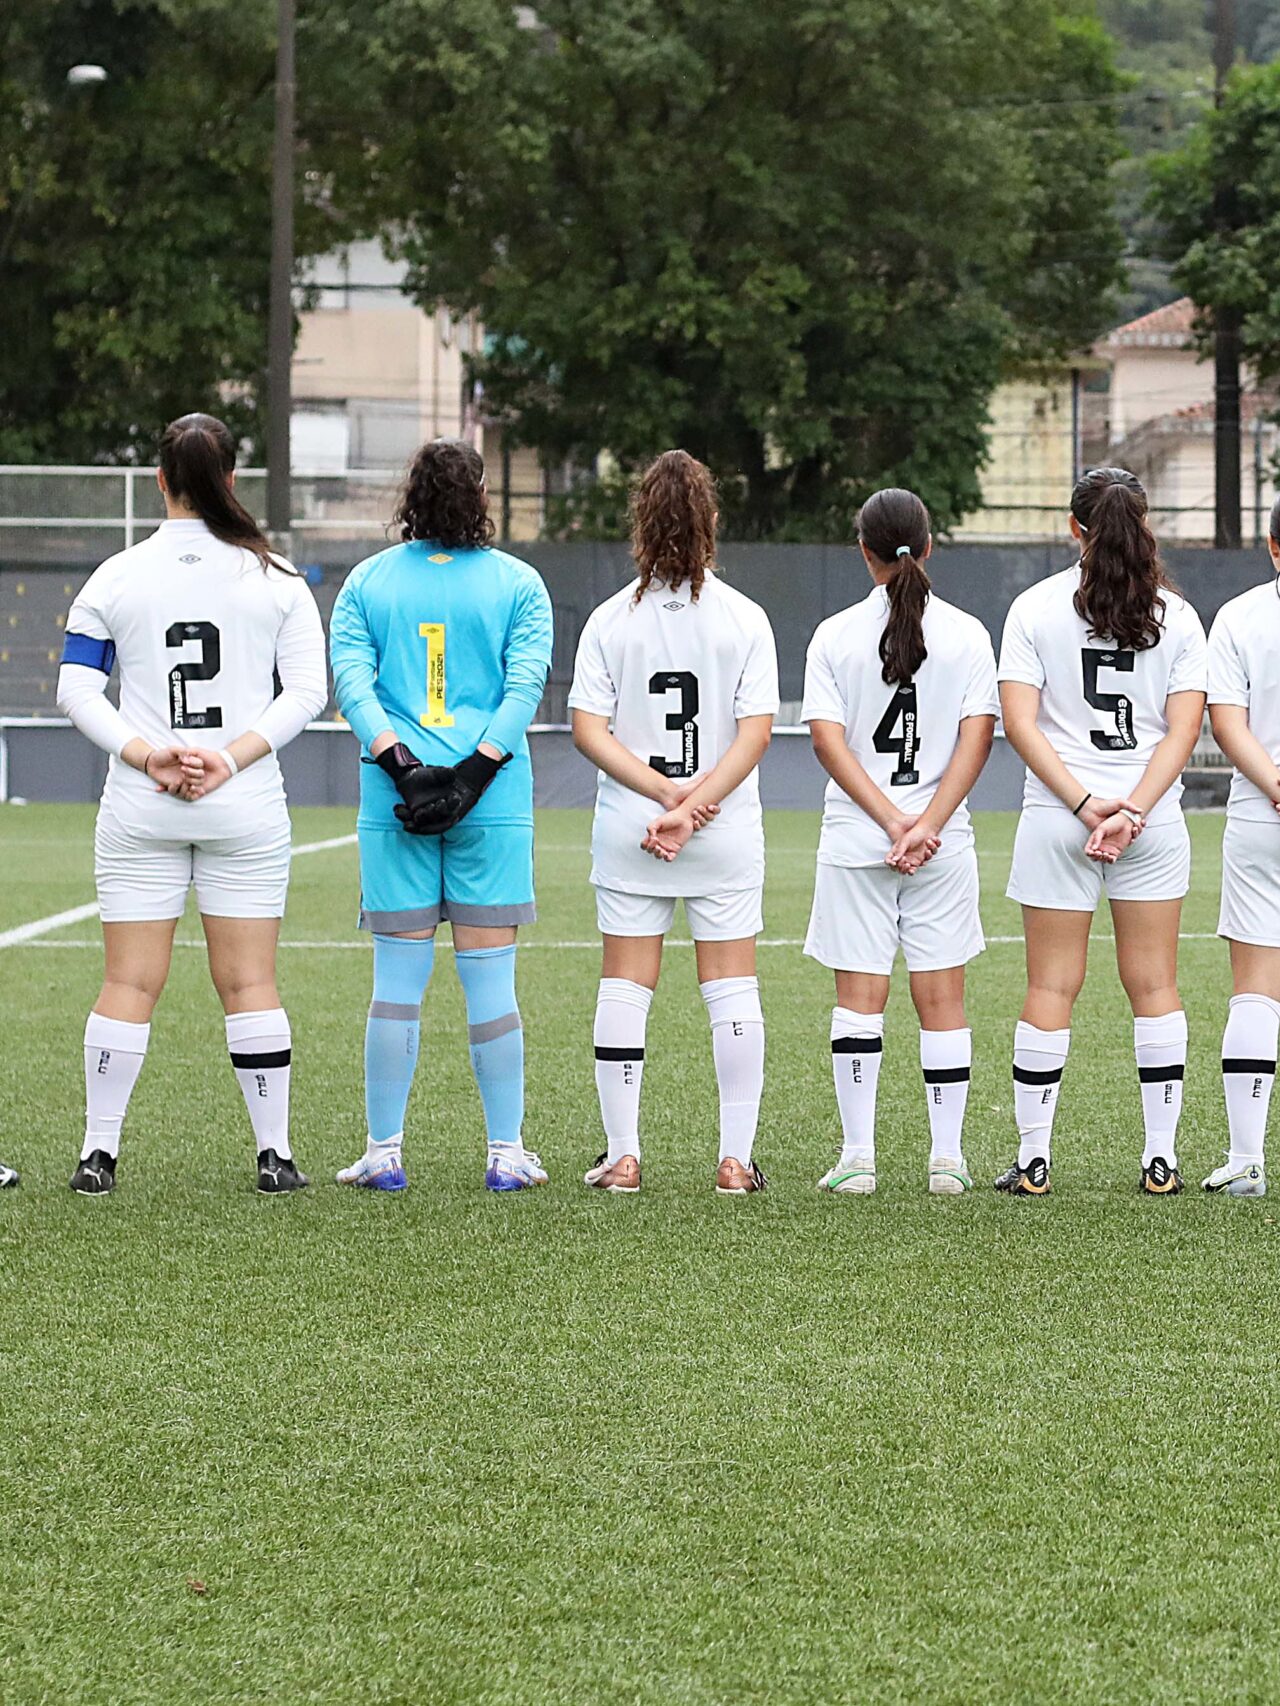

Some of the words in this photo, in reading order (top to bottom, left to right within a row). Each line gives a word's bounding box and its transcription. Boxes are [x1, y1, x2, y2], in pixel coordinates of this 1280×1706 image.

[166, 621, 223, 730] 2
[418, 622, 456, 728] 1
[648, 671, 699, 778] 3
[1081, 648, 1138, 751] 5
[872, 683, 921, 787] 4
[852, 1059, 862, 1084] SFC
[1164, 1083, 1172, 1104] SFC
[1252, 1077, 1262, 1098] SFC
